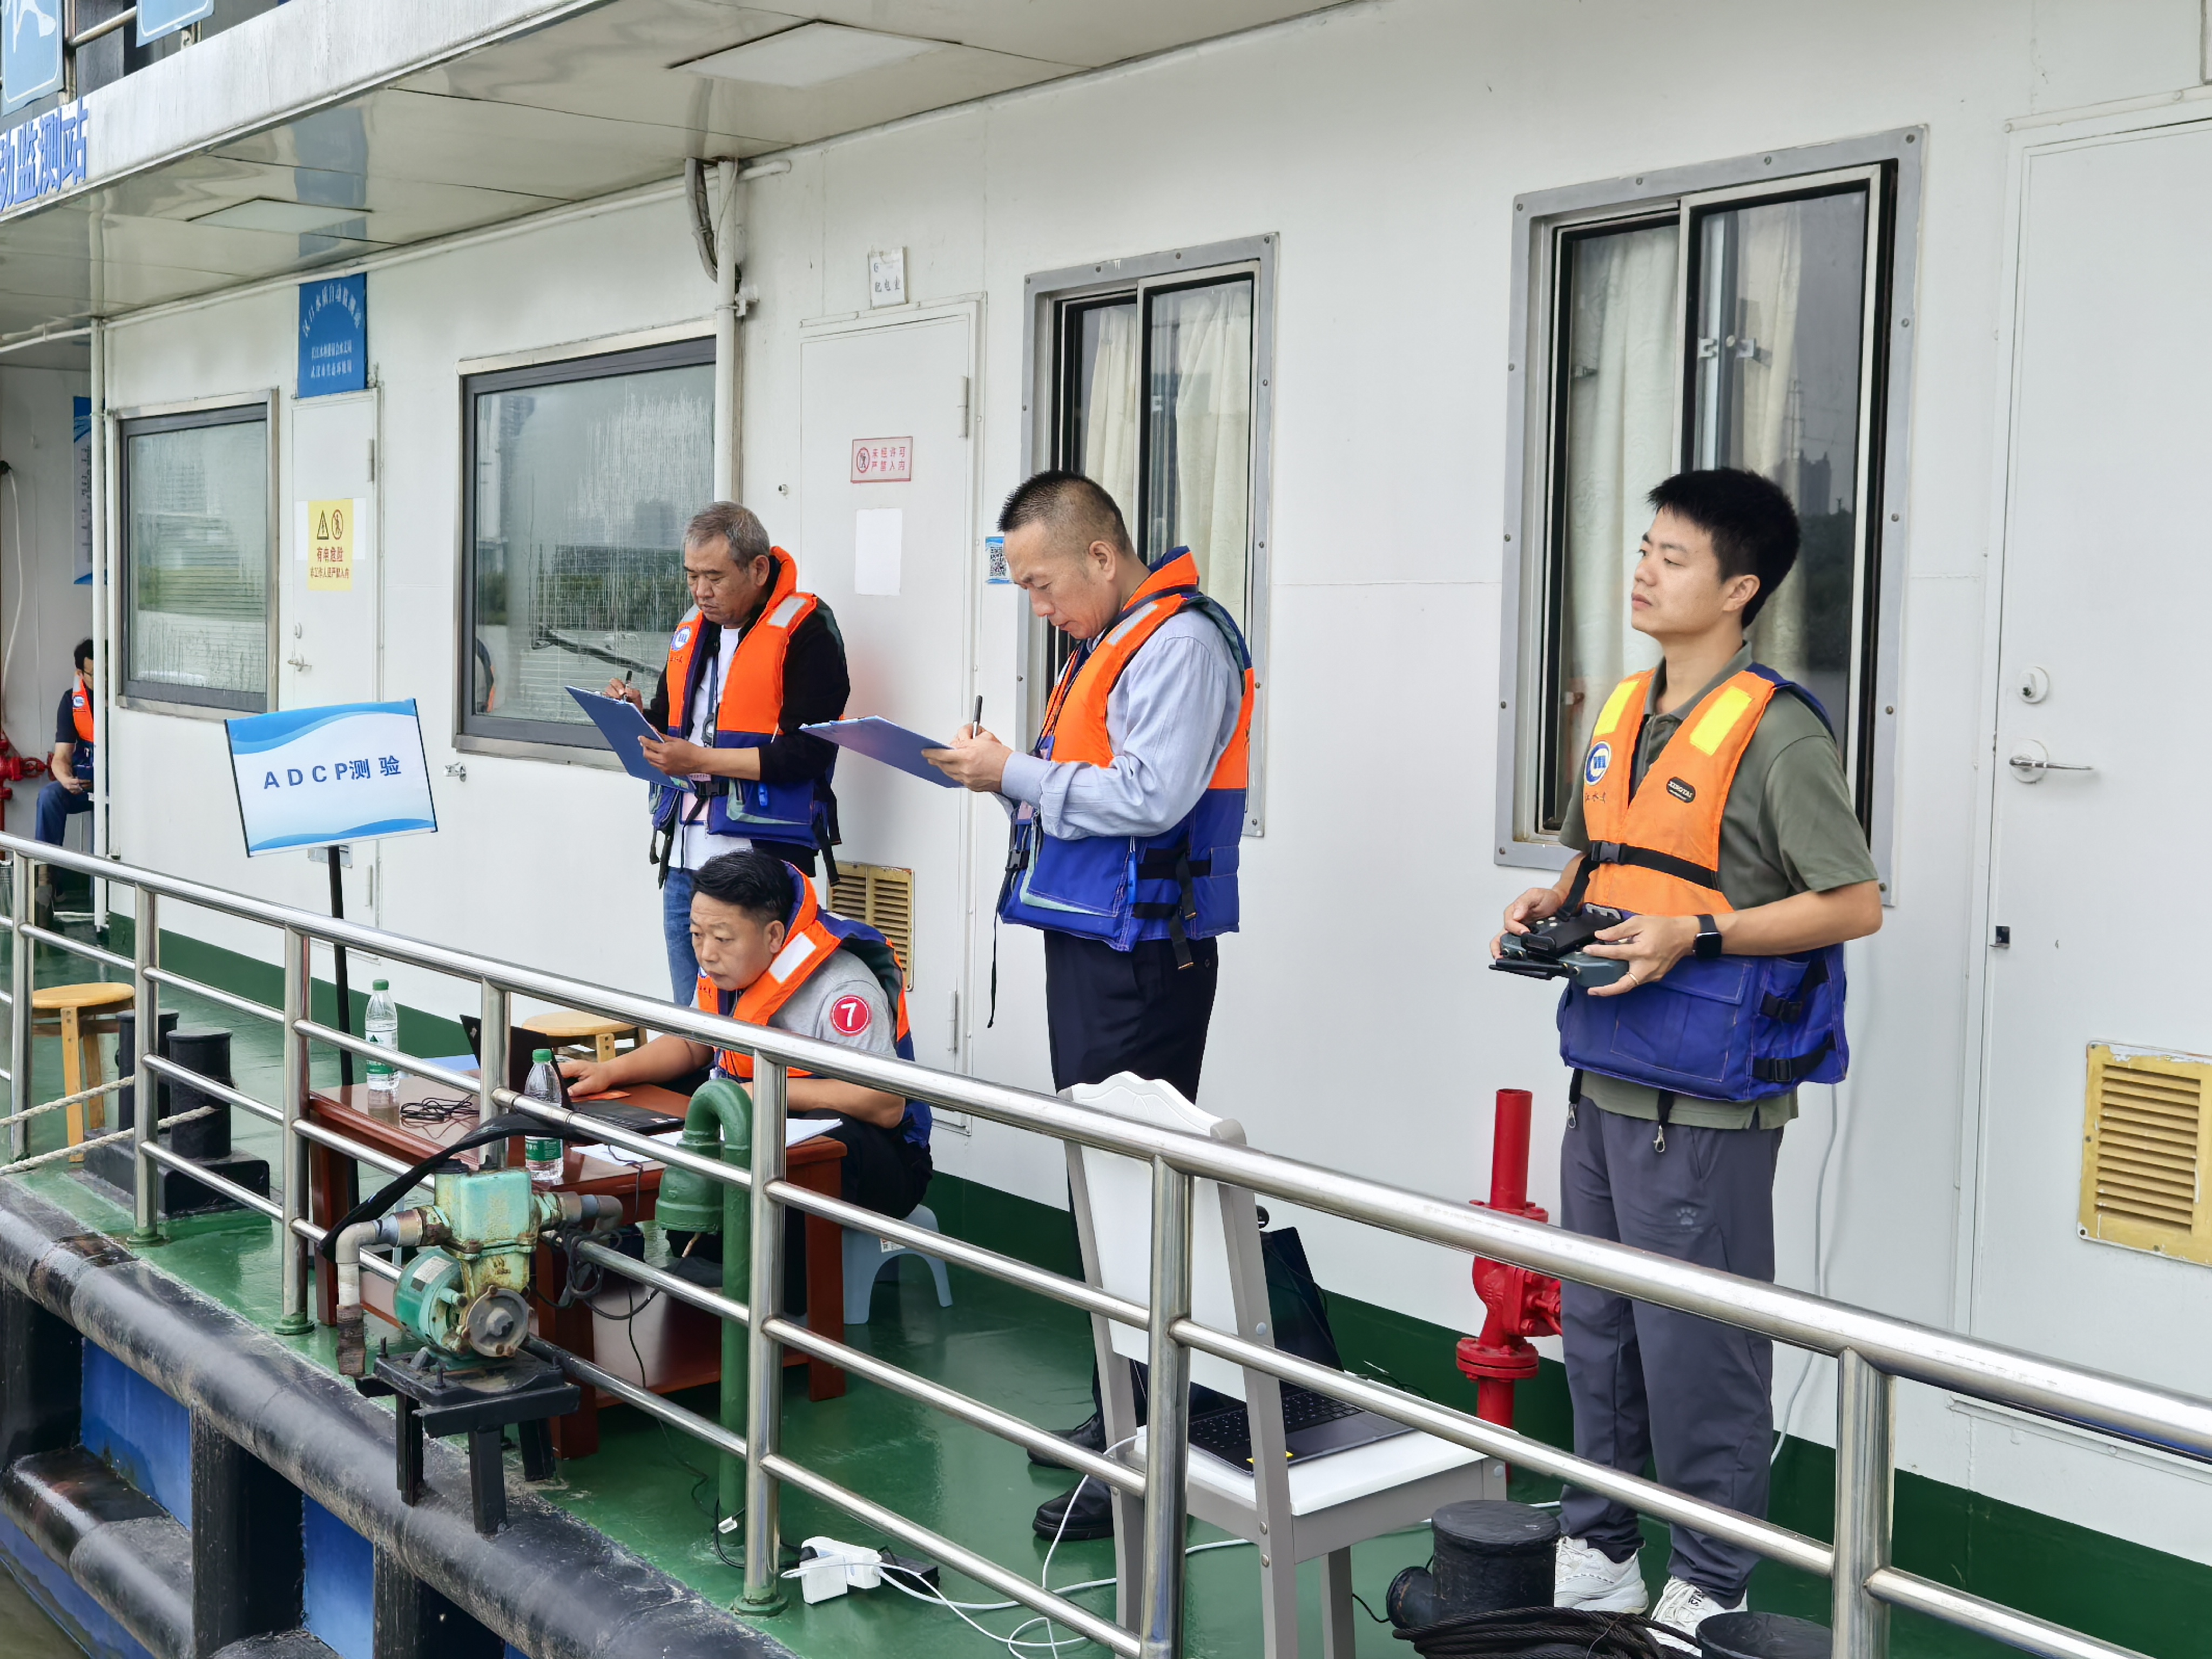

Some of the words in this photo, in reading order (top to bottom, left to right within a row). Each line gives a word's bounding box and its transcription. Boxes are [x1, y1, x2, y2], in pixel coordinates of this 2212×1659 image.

[872, 447, 906, 458] 未经许可
[871, 460, 906, 473] 严禁入内
[316, 547, 343, 563] 有电危险
[264, 755, 402, 790] ADCP测验
[841, 1002, 857, 1027] 7
